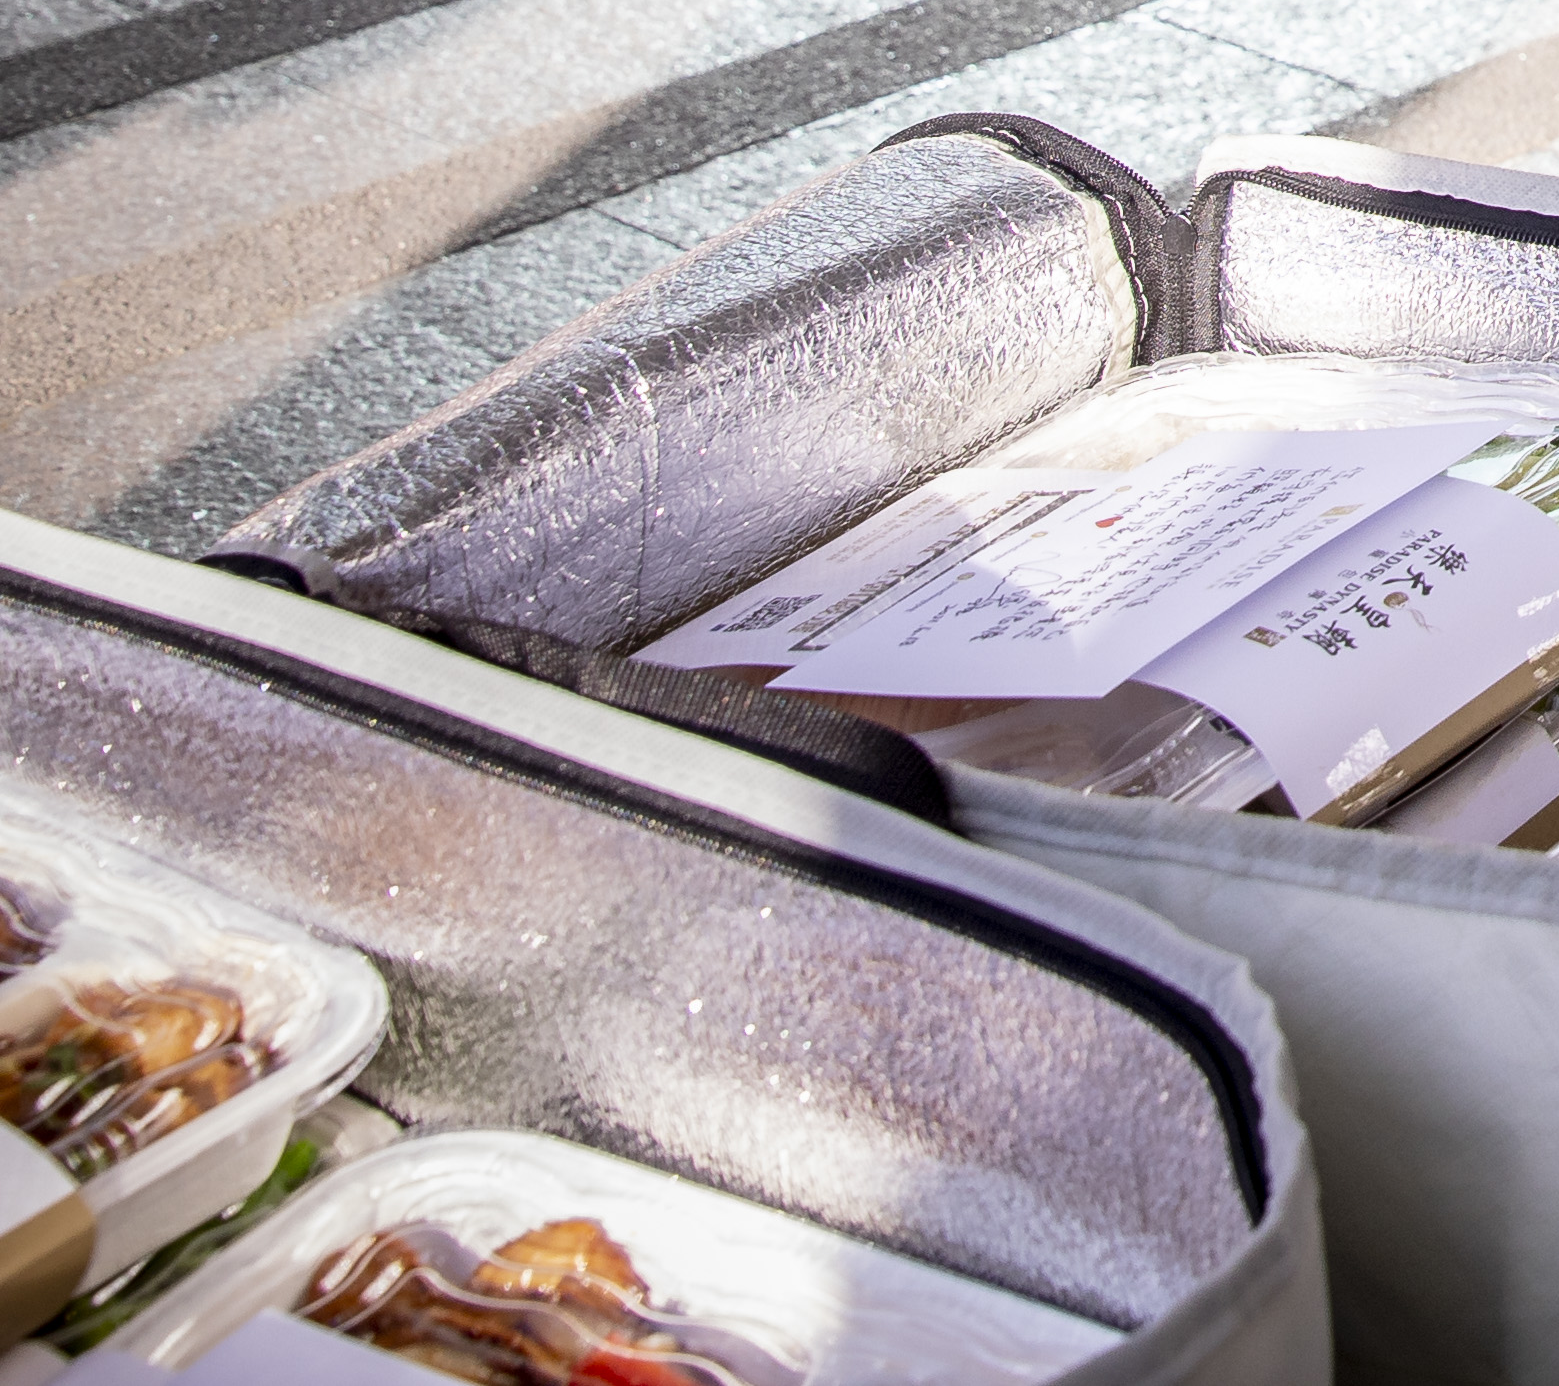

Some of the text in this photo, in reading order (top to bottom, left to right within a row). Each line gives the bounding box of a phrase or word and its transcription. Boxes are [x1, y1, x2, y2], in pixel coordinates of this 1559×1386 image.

[1219, 518, 1339, 589] PARADISE
[1284, 529, 1442, 633] PARADISE DYNASTY
[1302, 544, 1469, 656] 樂天皇朝
